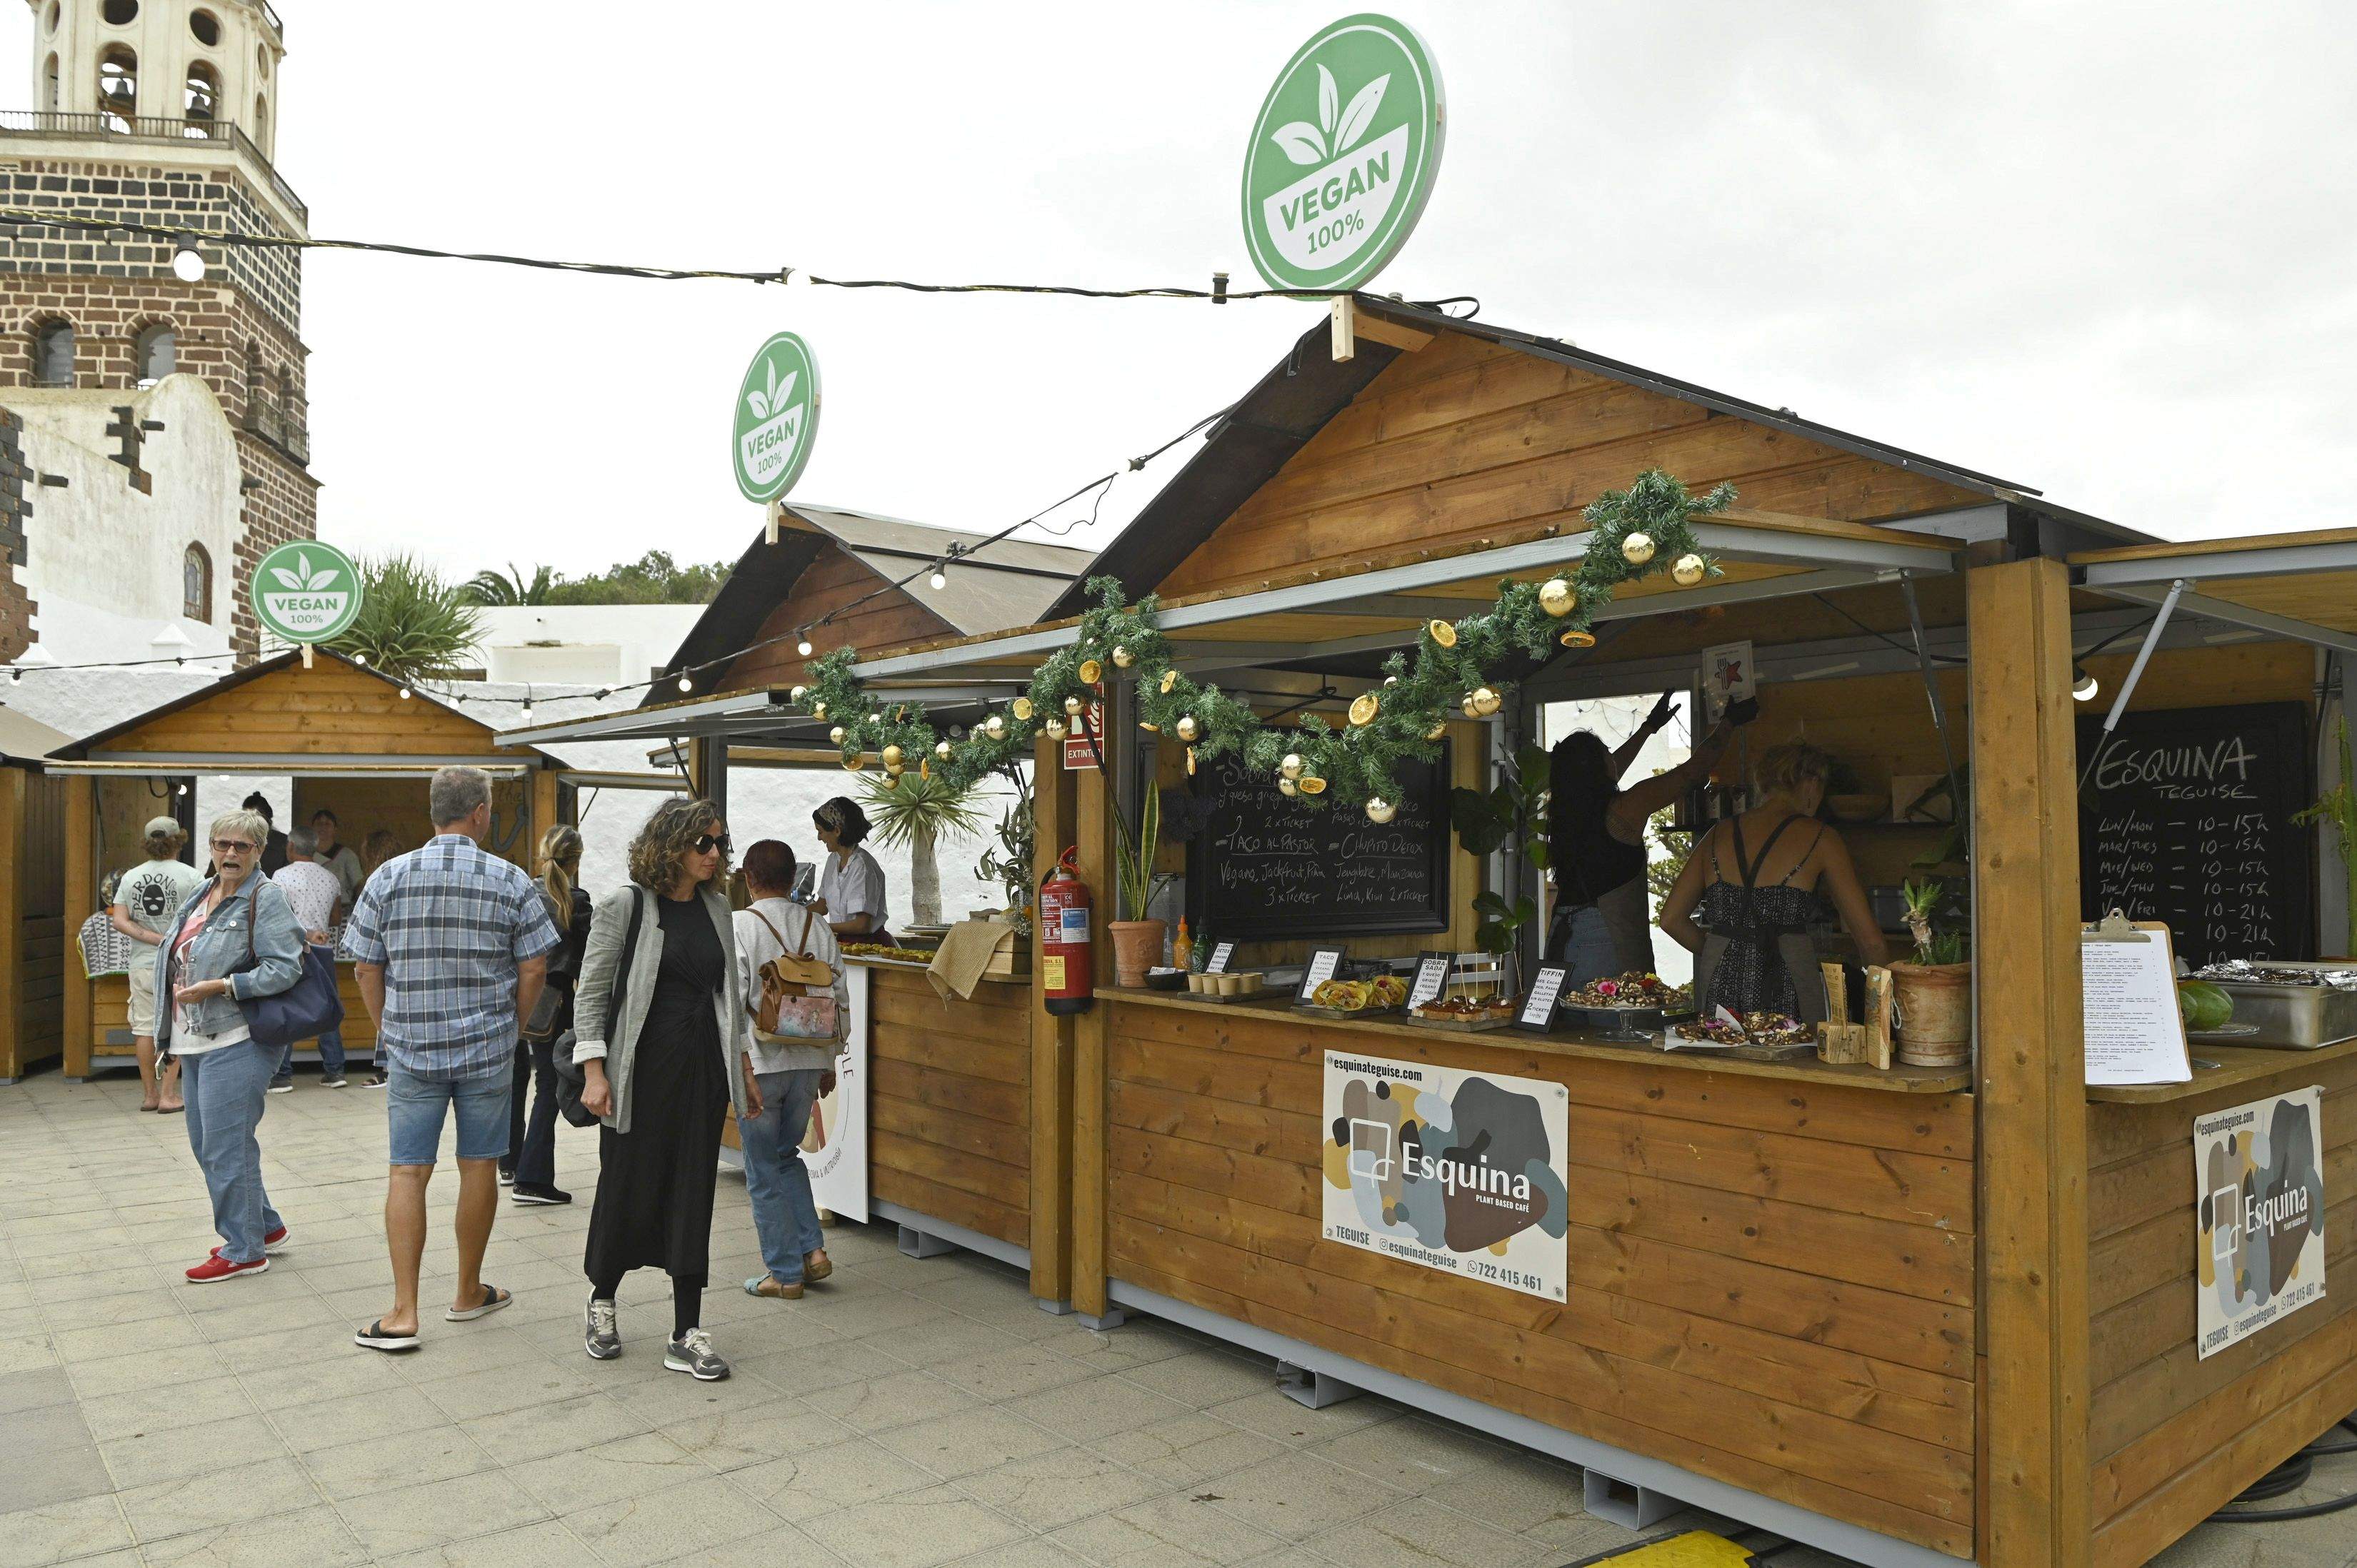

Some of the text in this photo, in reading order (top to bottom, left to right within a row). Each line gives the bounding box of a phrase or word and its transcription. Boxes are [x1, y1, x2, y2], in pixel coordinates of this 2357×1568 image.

[1279, 151, 1390, 232] VEGAN
[1308, 209, 1364, 254] 100%
[748, 417, 794, 458] VEGAN
[758, 451, 782, 474] 100%
[274, 598, 338, 610] VEGAN
[291, 615, 324, 623] 100%
[2152, 785, 2258, 799] TEGUISE
[1526, 1002, 1533, 1010] 2
[1333, 1057, 1423, 1081] esquinateguise.com
[1402, 1141, 1531, 1201] Esquina
[1476, 1194, 1530, 1213] PLANT BASED CAFÉ
[2245, 1179, 2308, 1237] Esquina
[1336, 1225, 1370, 1245] TEGUISE
[1388, 1240, 1457, 1269] esquinateguise
[1478, 1262, 1542, 1291] 722 415 461
[2286, 1282, 2315, 1309] 722 415 461
[2206, 1325, 2229, 1349] TEGUISE
